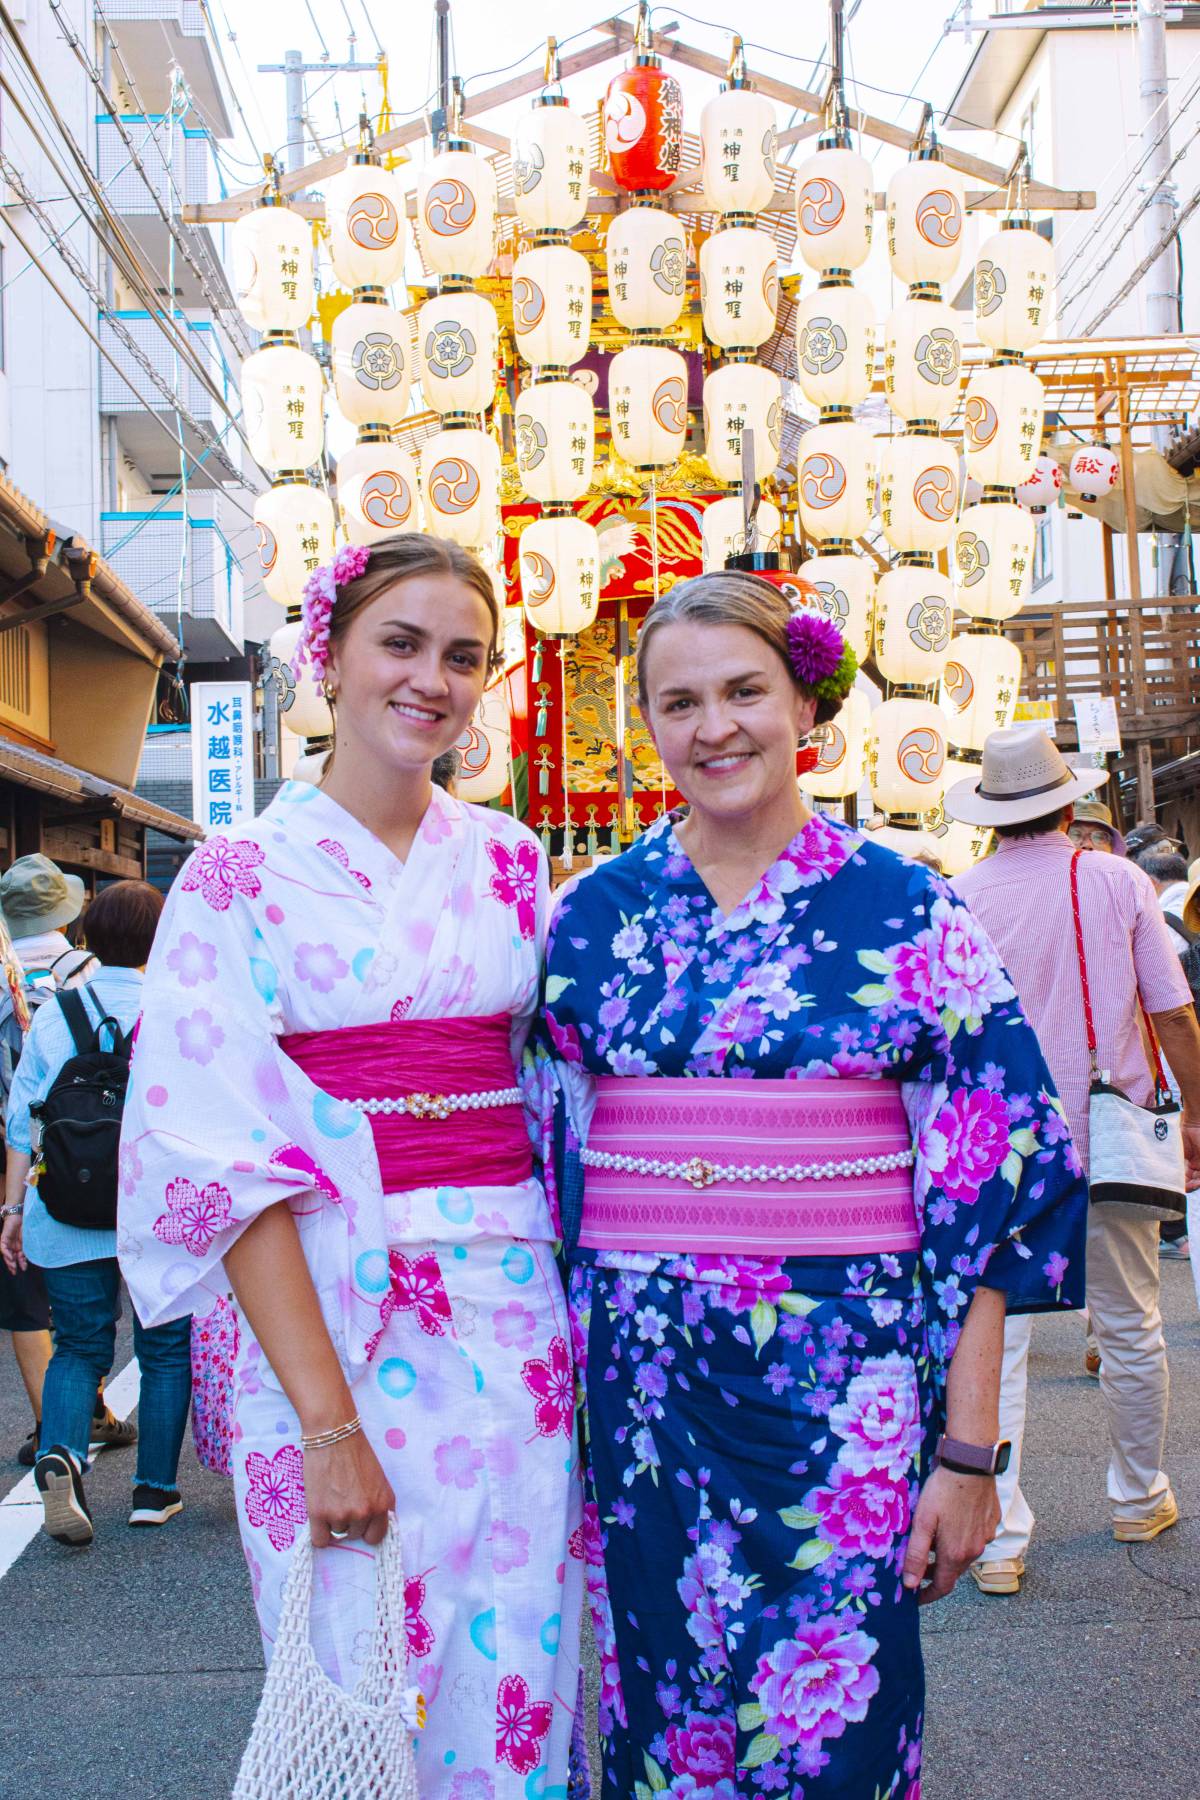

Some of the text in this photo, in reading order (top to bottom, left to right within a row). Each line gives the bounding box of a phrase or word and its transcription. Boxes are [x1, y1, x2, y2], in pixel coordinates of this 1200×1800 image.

[568, 160, 583, 200] 神聖
[722, 141, 741, 182] 神聖
[280, 259, 298, 300] 神聖
[614, 261, 628, 301] 神聖
[724, 279, 743, 319] 神聖
[568, 299, 583, 339] 神聖
[1028, 285, 1044, 326] 神聖
[286, 398, 305, 439] 神聖
[616, 400, 631, 439] 神聖
[571, 436, 586, 475] 神聖
[1020, 421, 1036, 461] 神聖
[579, 571, 595, 610] 神聖
[1009, 558, 1025, 596] 神聖
[995, 689, 1012, 727] 神聖
[207, 701, 232, 825] 水越医院
